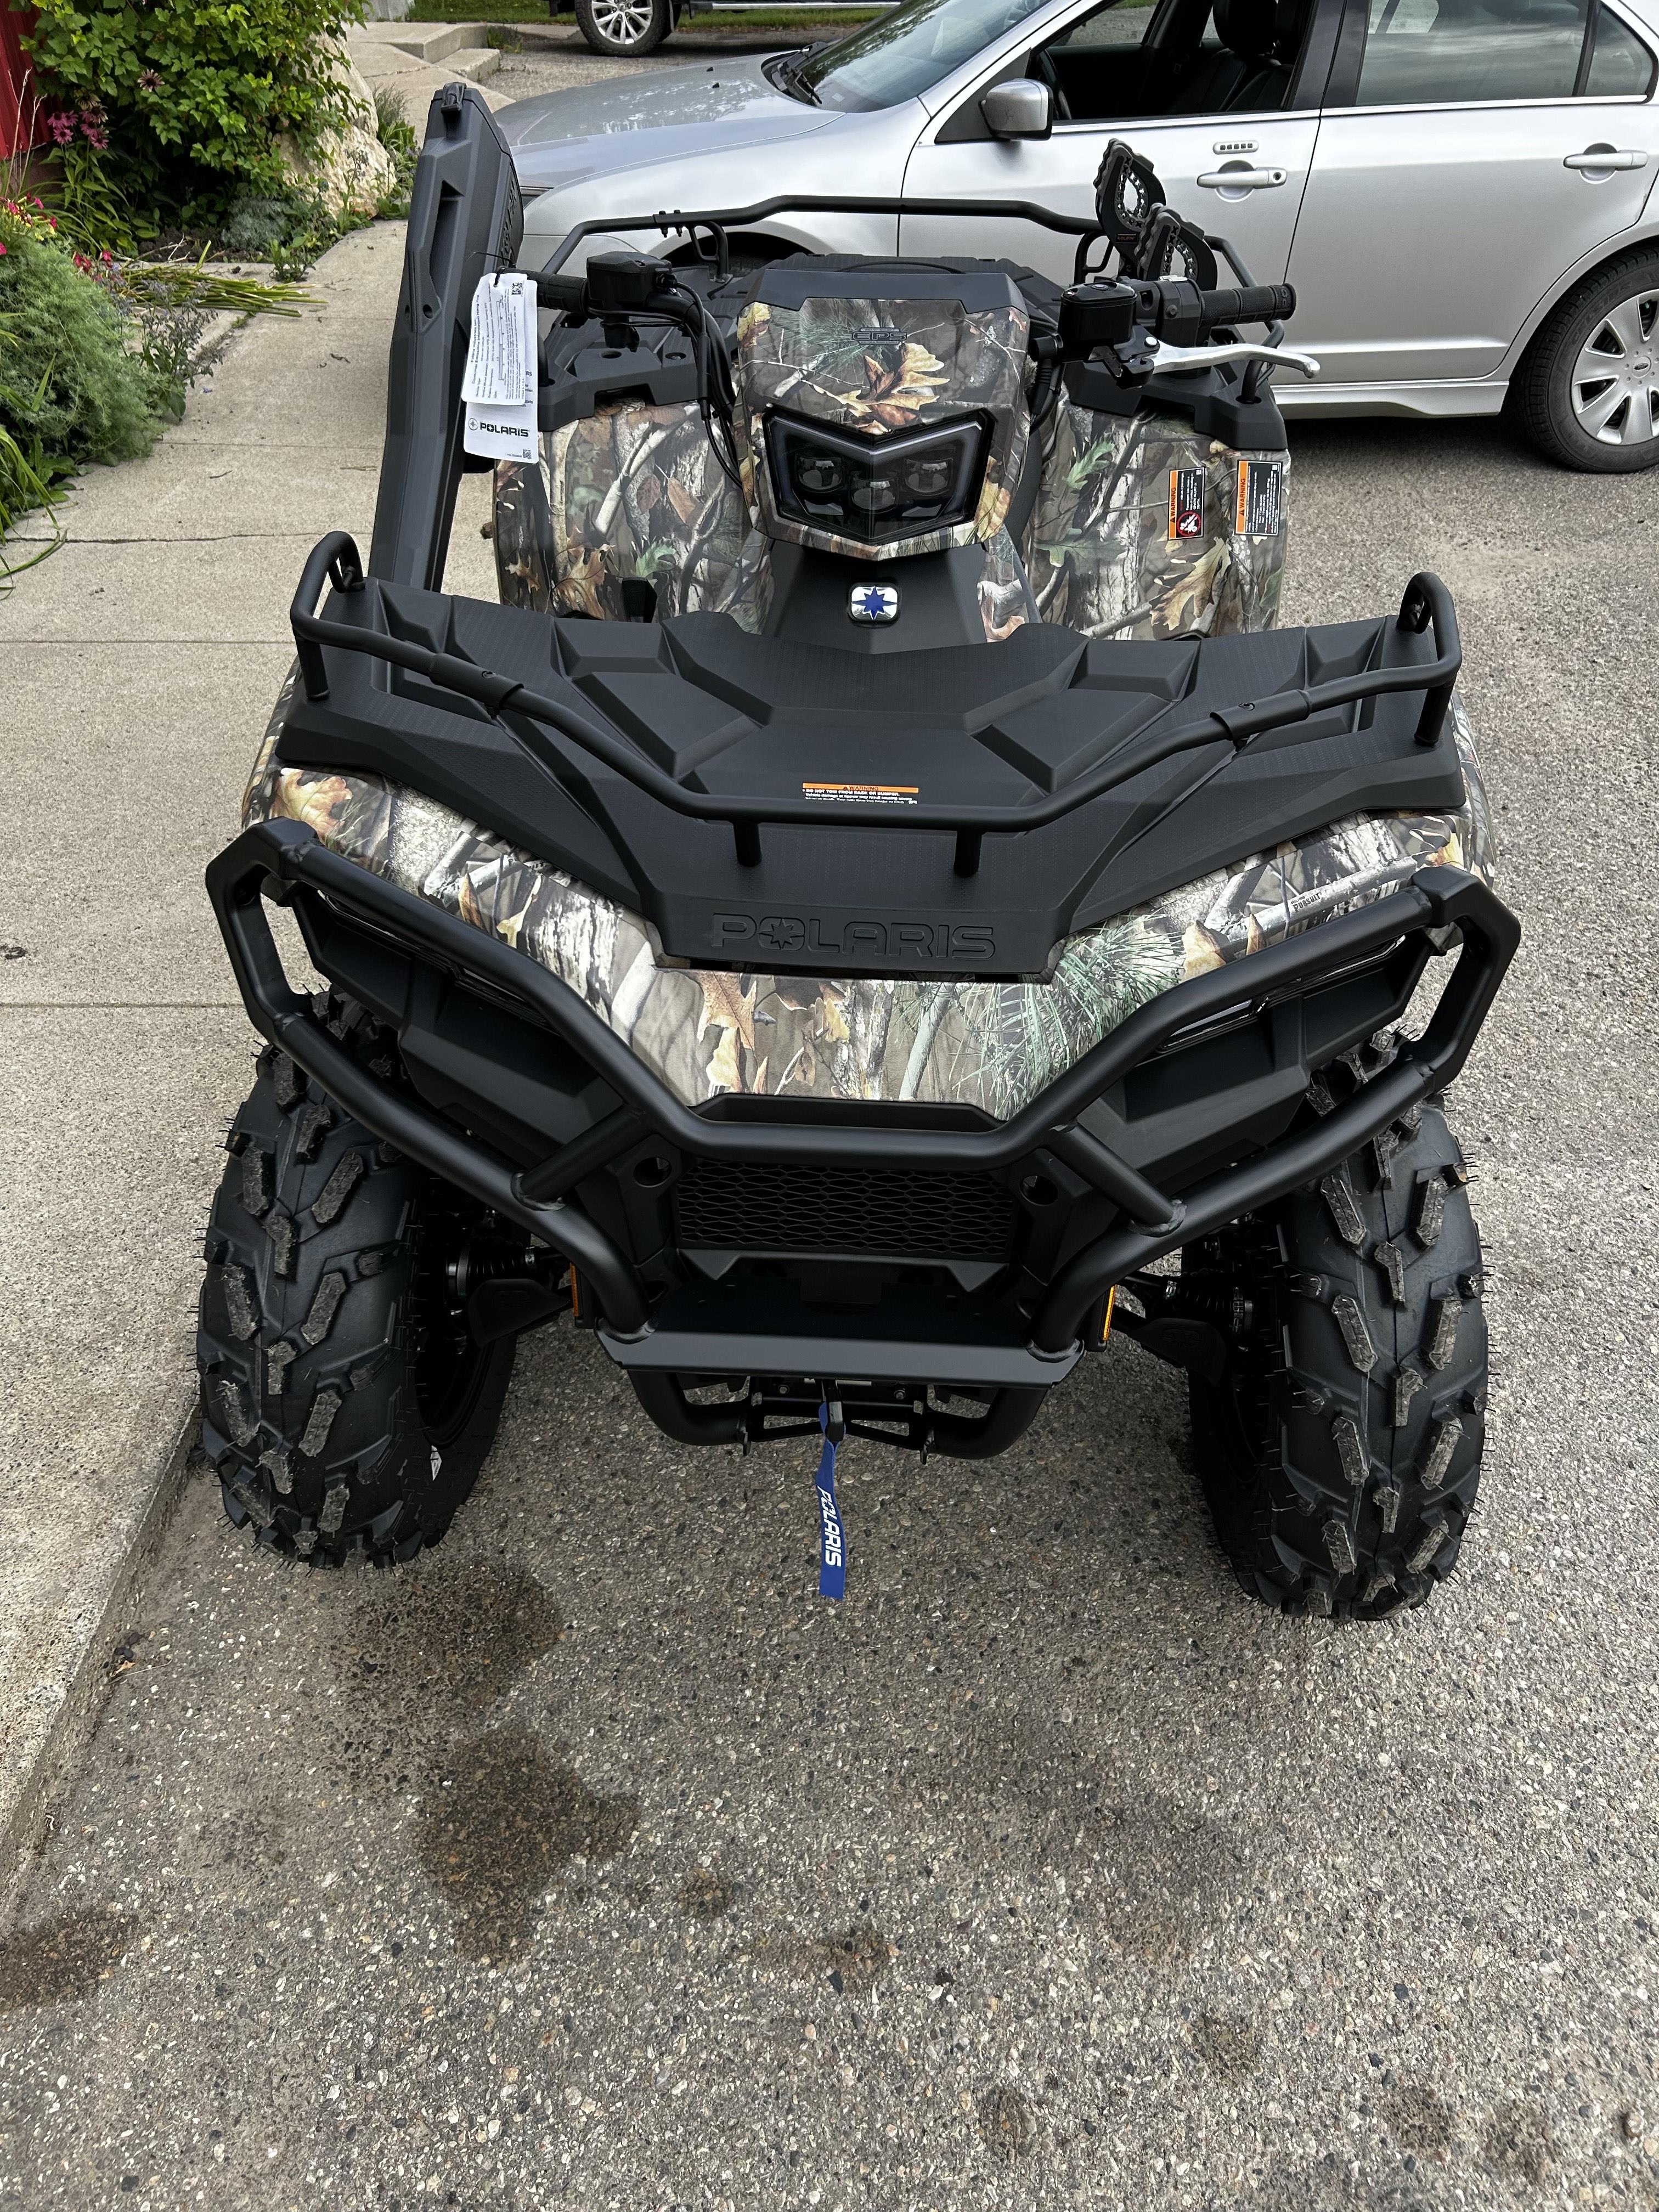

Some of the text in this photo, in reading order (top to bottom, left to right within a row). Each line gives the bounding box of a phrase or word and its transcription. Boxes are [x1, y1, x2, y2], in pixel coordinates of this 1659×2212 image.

[853, 332, 907, 341] EPS
[480, 422, 529, 437] POLARIS
[1293, 891, 1321, 913] PURSUIT
[711, 912, 996, 961] POLARIS
[817, 1485, 842, 1567] POLARIS
